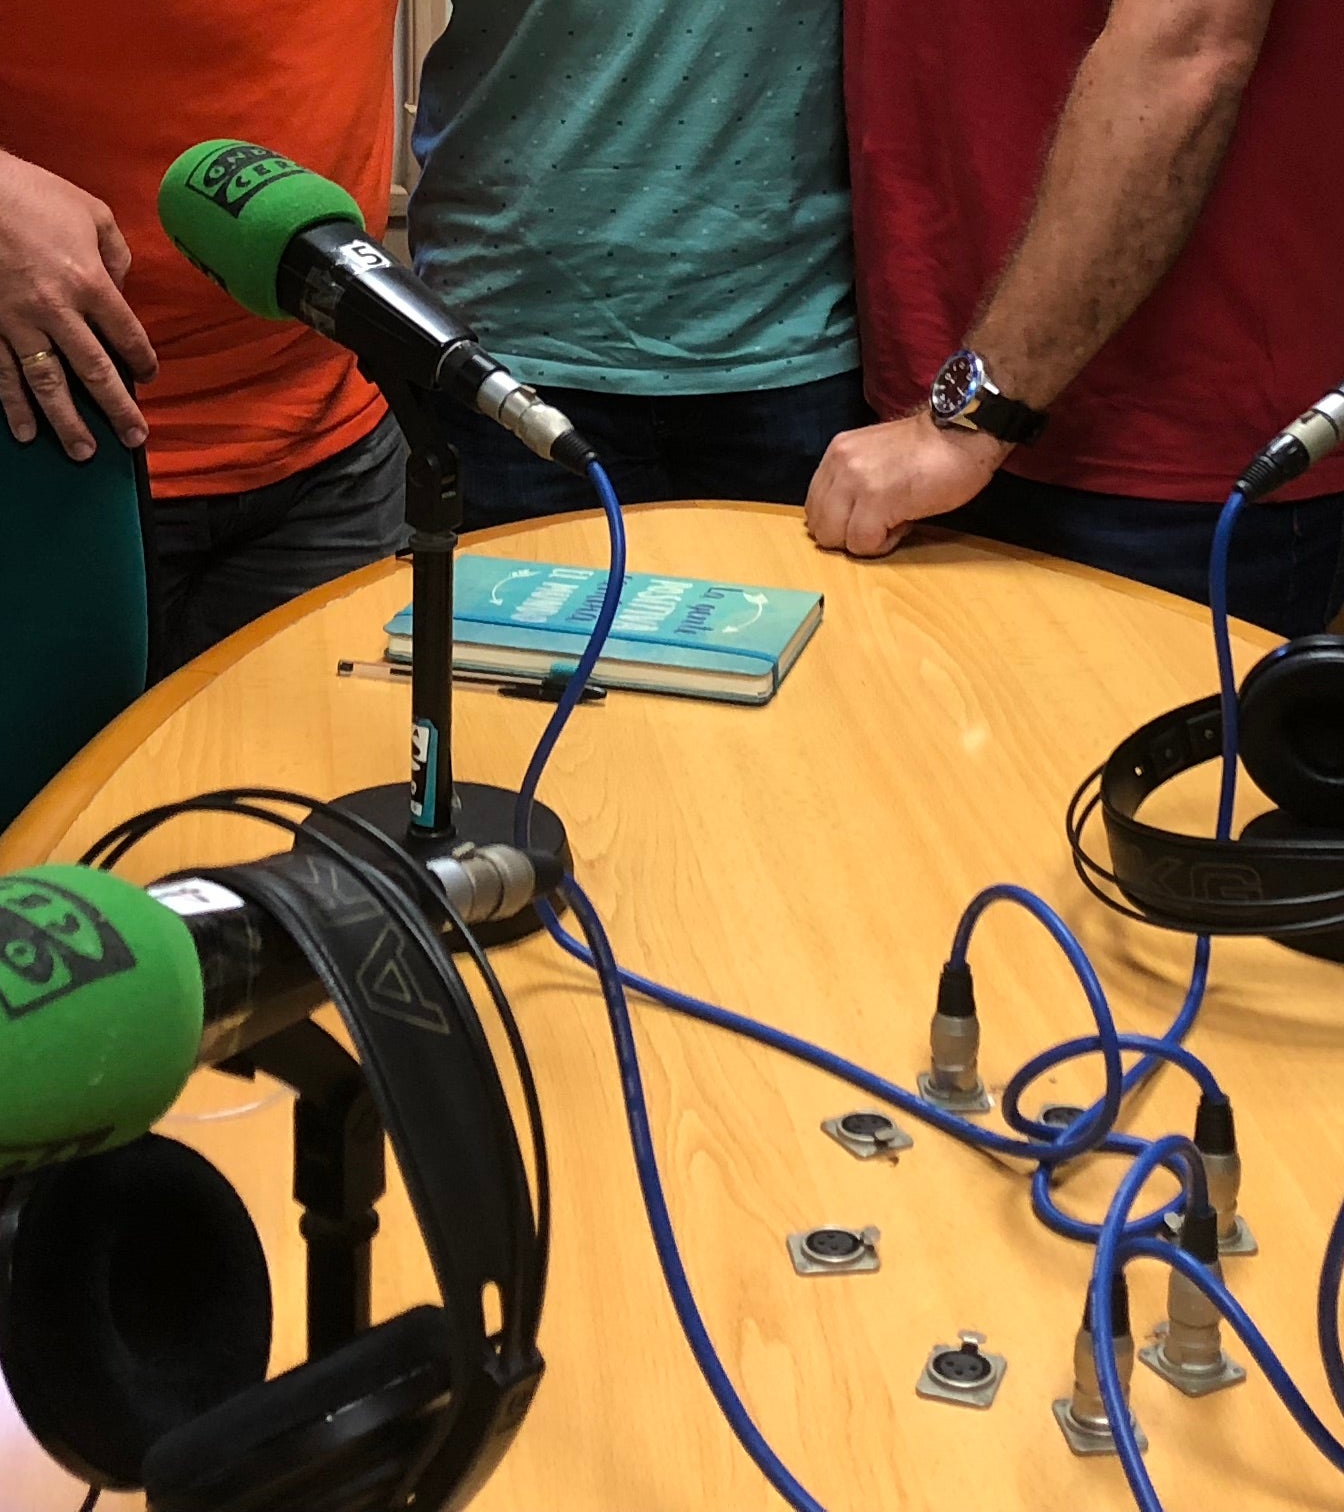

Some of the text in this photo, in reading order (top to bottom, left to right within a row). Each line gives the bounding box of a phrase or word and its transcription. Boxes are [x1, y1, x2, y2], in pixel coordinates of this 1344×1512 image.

[207, 146, 278, 179] OND
[235, 159, 292, 188] CER
[351, 245, 383, 266] 5
[612, 578, 694, 632] POSITIVA
[673, 586, 745, 635] La gente
